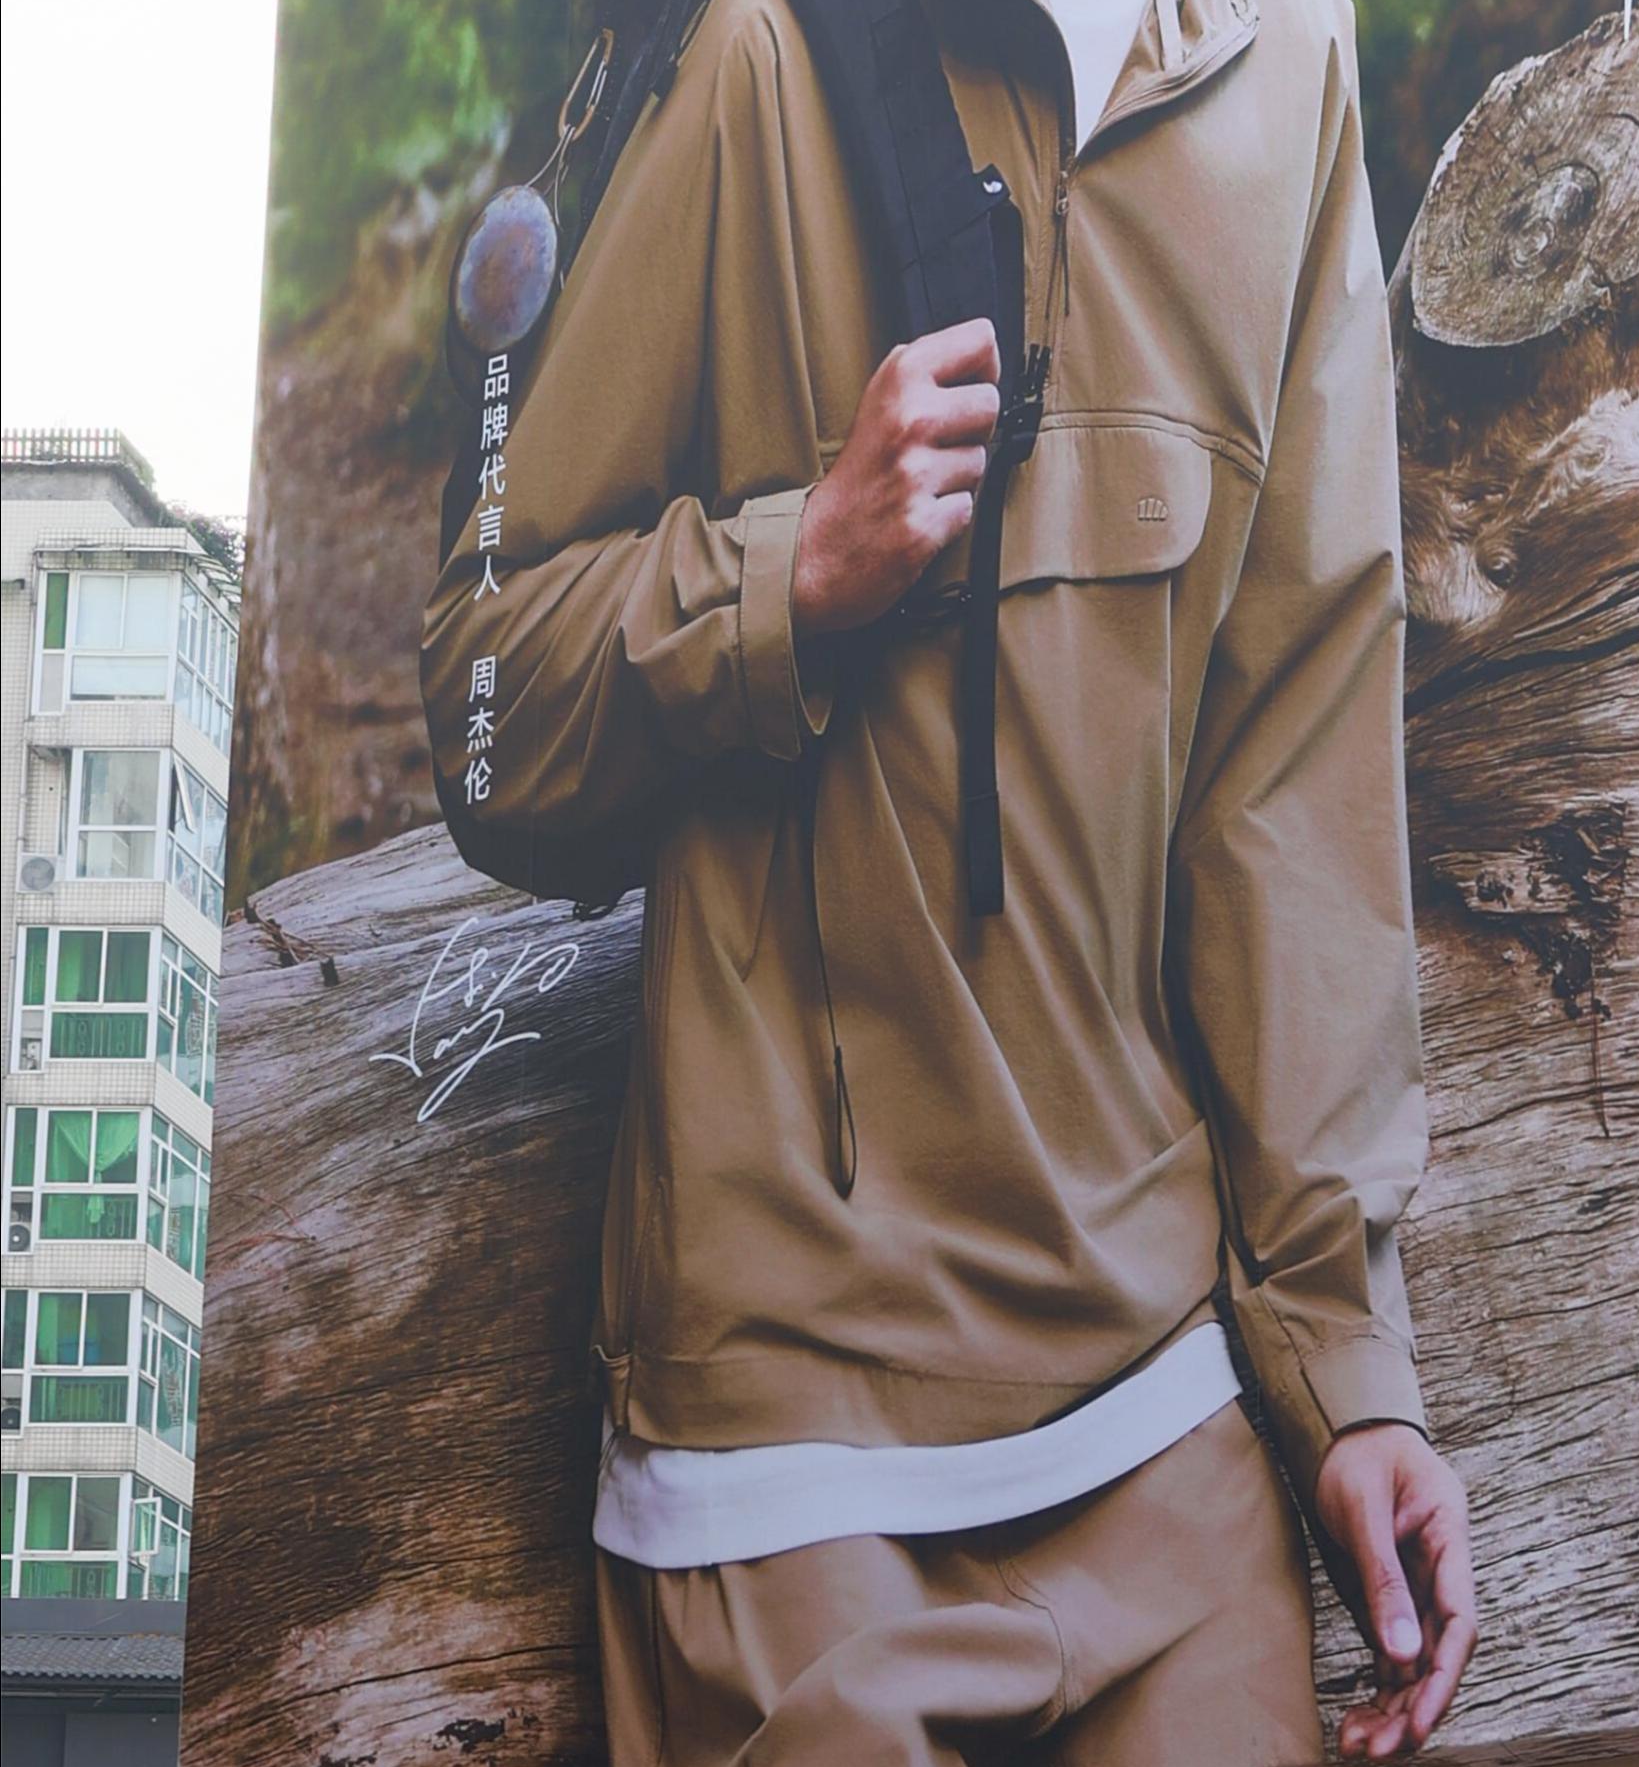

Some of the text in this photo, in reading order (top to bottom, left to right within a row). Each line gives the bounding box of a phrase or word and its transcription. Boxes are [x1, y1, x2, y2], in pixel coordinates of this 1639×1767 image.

[464, 352, 510, 807] 品牌代言人 周杰伦
